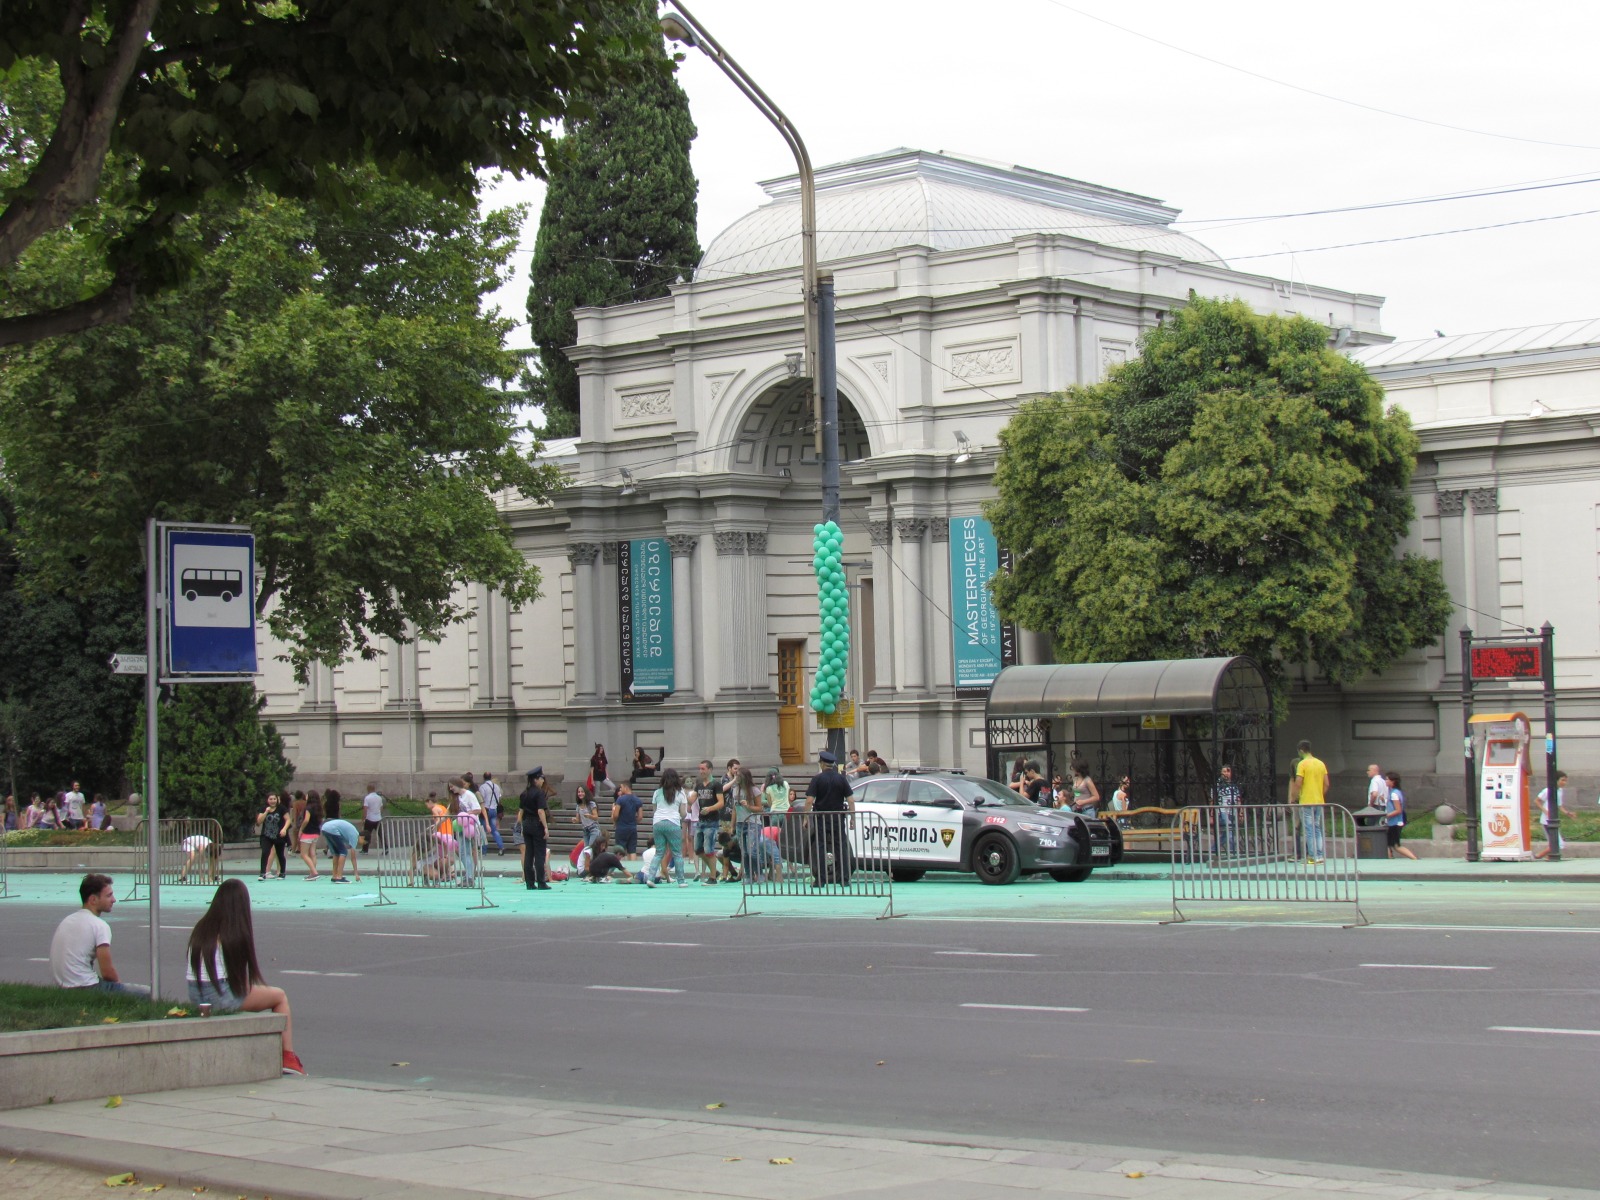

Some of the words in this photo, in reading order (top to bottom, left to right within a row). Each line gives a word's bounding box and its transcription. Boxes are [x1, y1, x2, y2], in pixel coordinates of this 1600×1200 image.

[620, 543, 629, 601] გალერეა
[964, 518, 979, 645] MASTERPIECES
[978, 557, 986, 578] FINE
[647, 541, 662, 657] შედევრები
[979, 580, 988, 629] GEORGIAN
[622, 605, 631, 674] ეროვნული
[981, 632, 989, 645] OF
[990, 634, 996, 644] OF
[864, 825, 938, 844] პოლიცია
[1039, 838, 1057, 847] 7104
